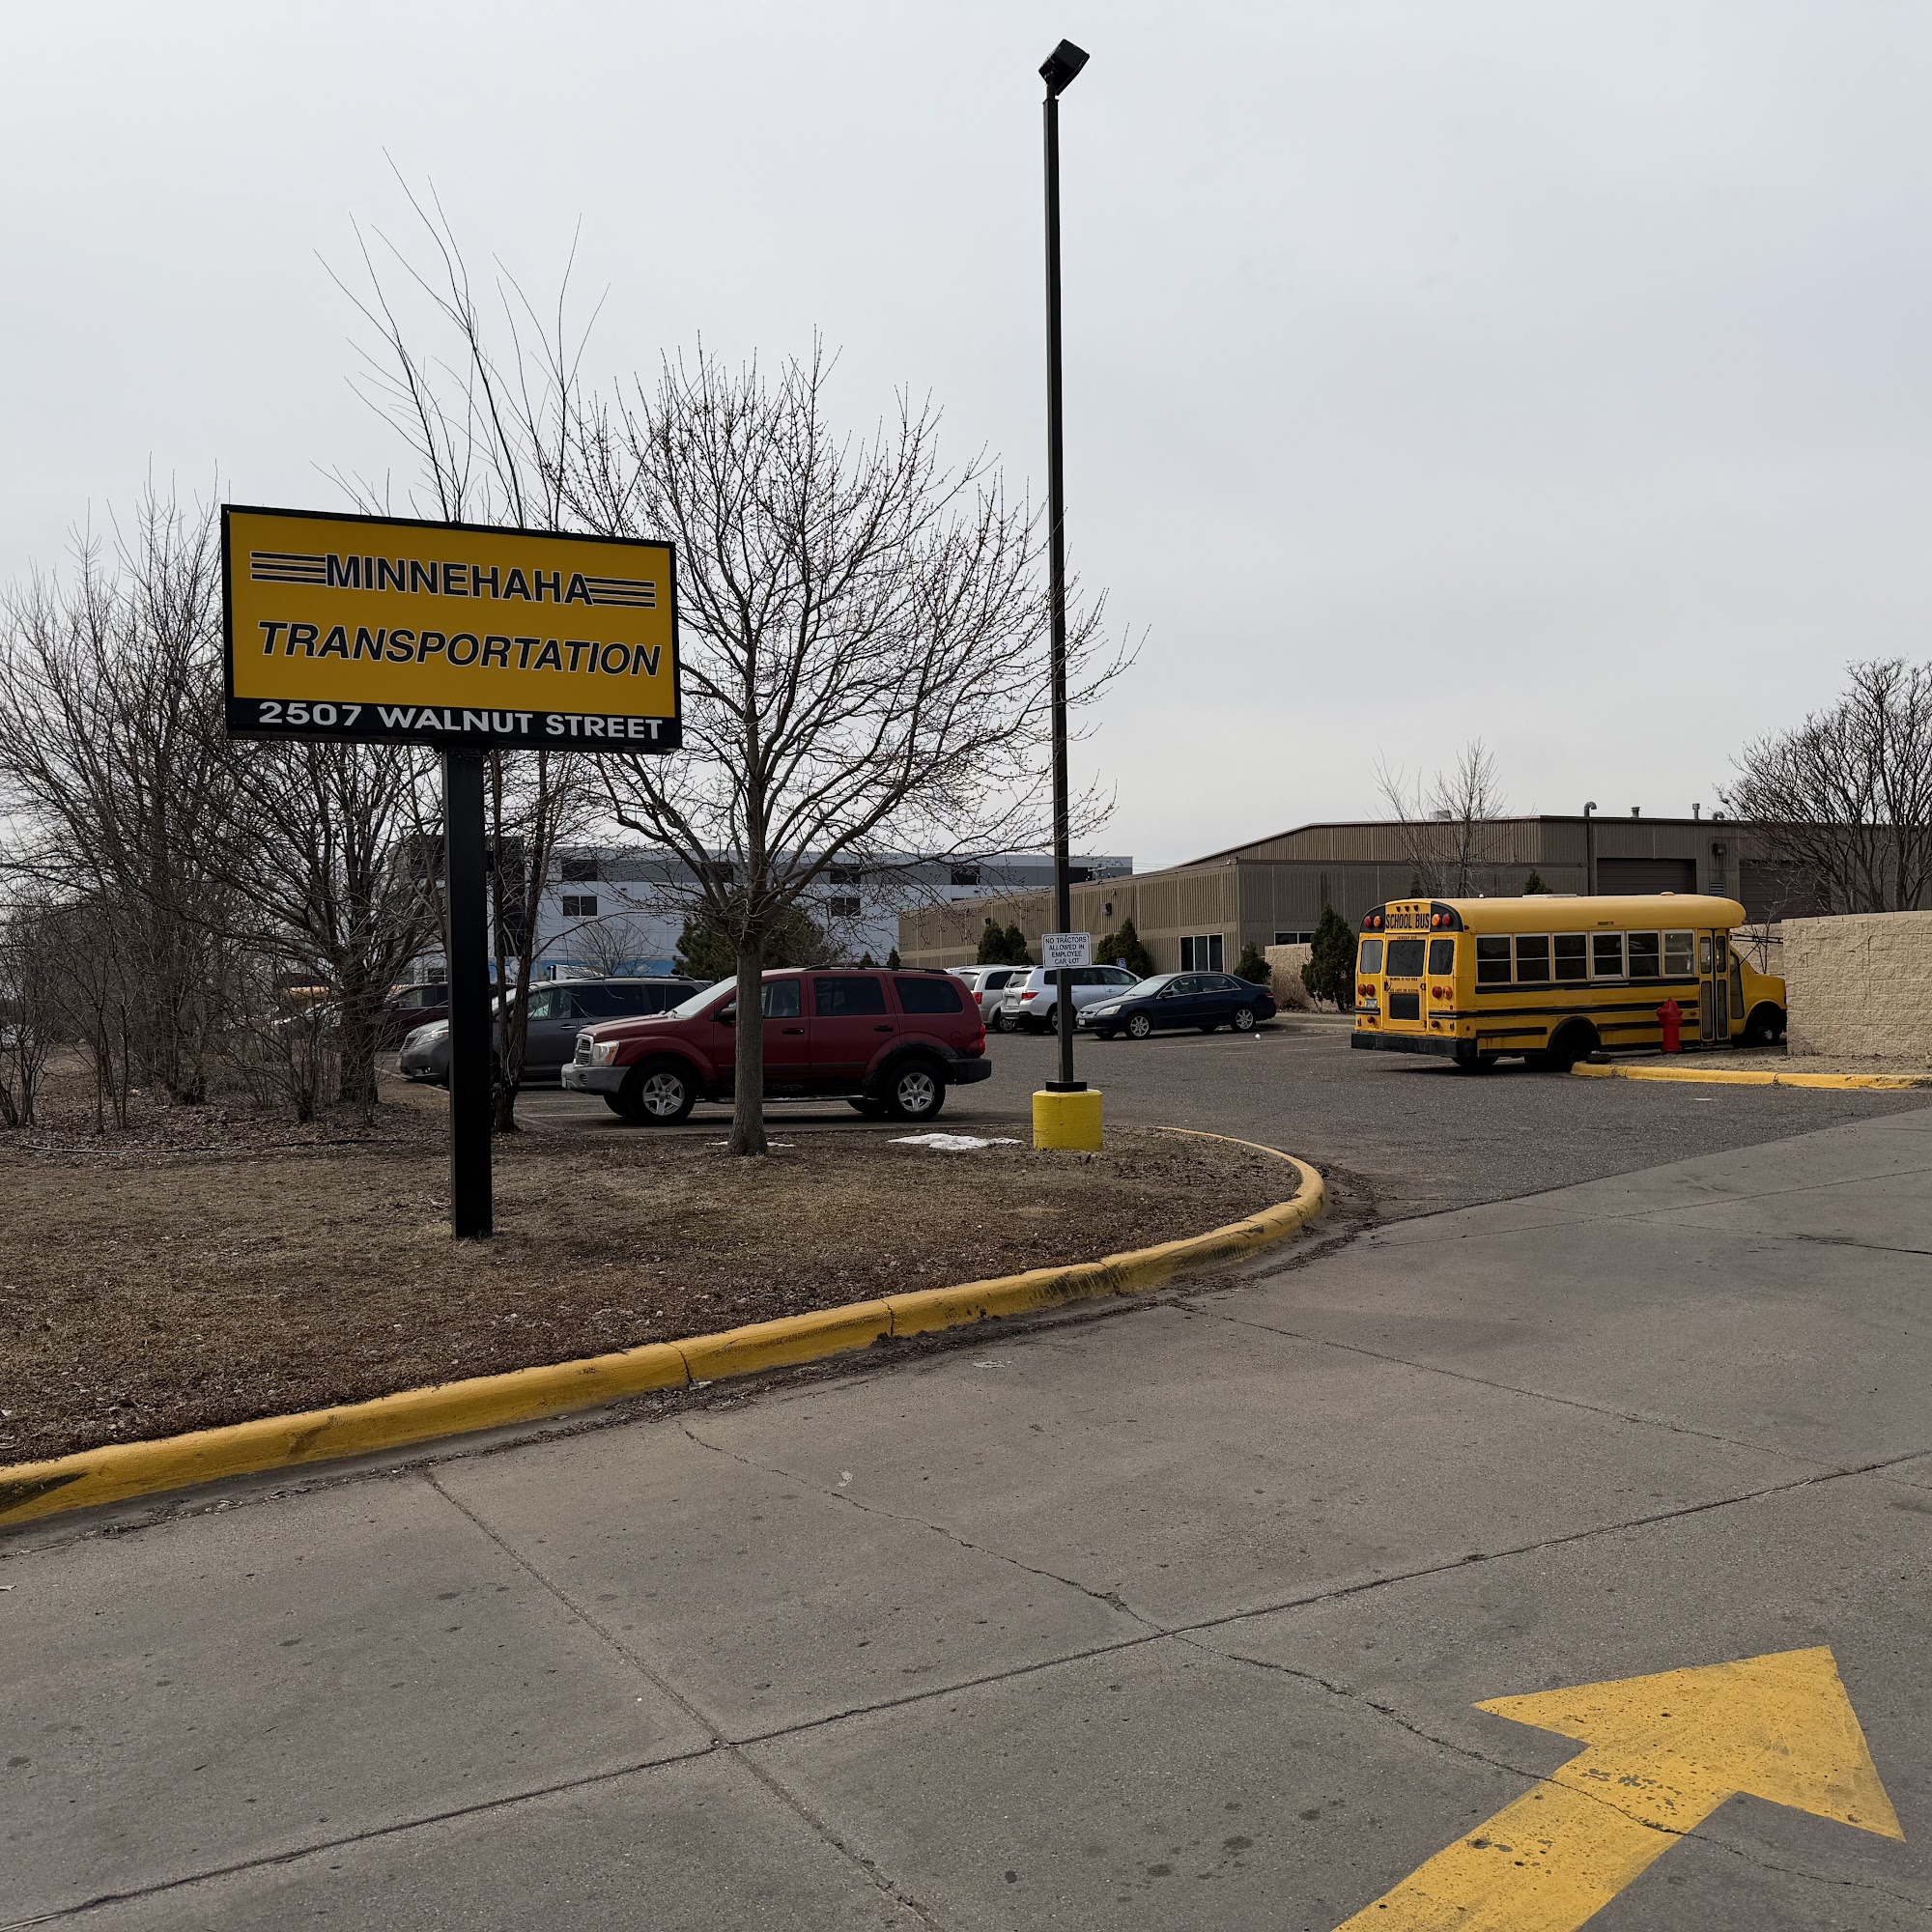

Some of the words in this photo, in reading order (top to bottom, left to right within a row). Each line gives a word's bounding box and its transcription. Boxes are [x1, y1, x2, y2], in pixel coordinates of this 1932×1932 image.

[326, 553, 594, 606] MINNEHAHA
[257, 620, 662, 676] TRANSPORTATION
[258, 701, 362, 726] 2507
[377, 706, 533, 734] WALNUT
[545, 715, 664, 739] STREET
[1385, 913, 1411, 928] SCHOOL
[1415, 913, 1430, 928] BUS
